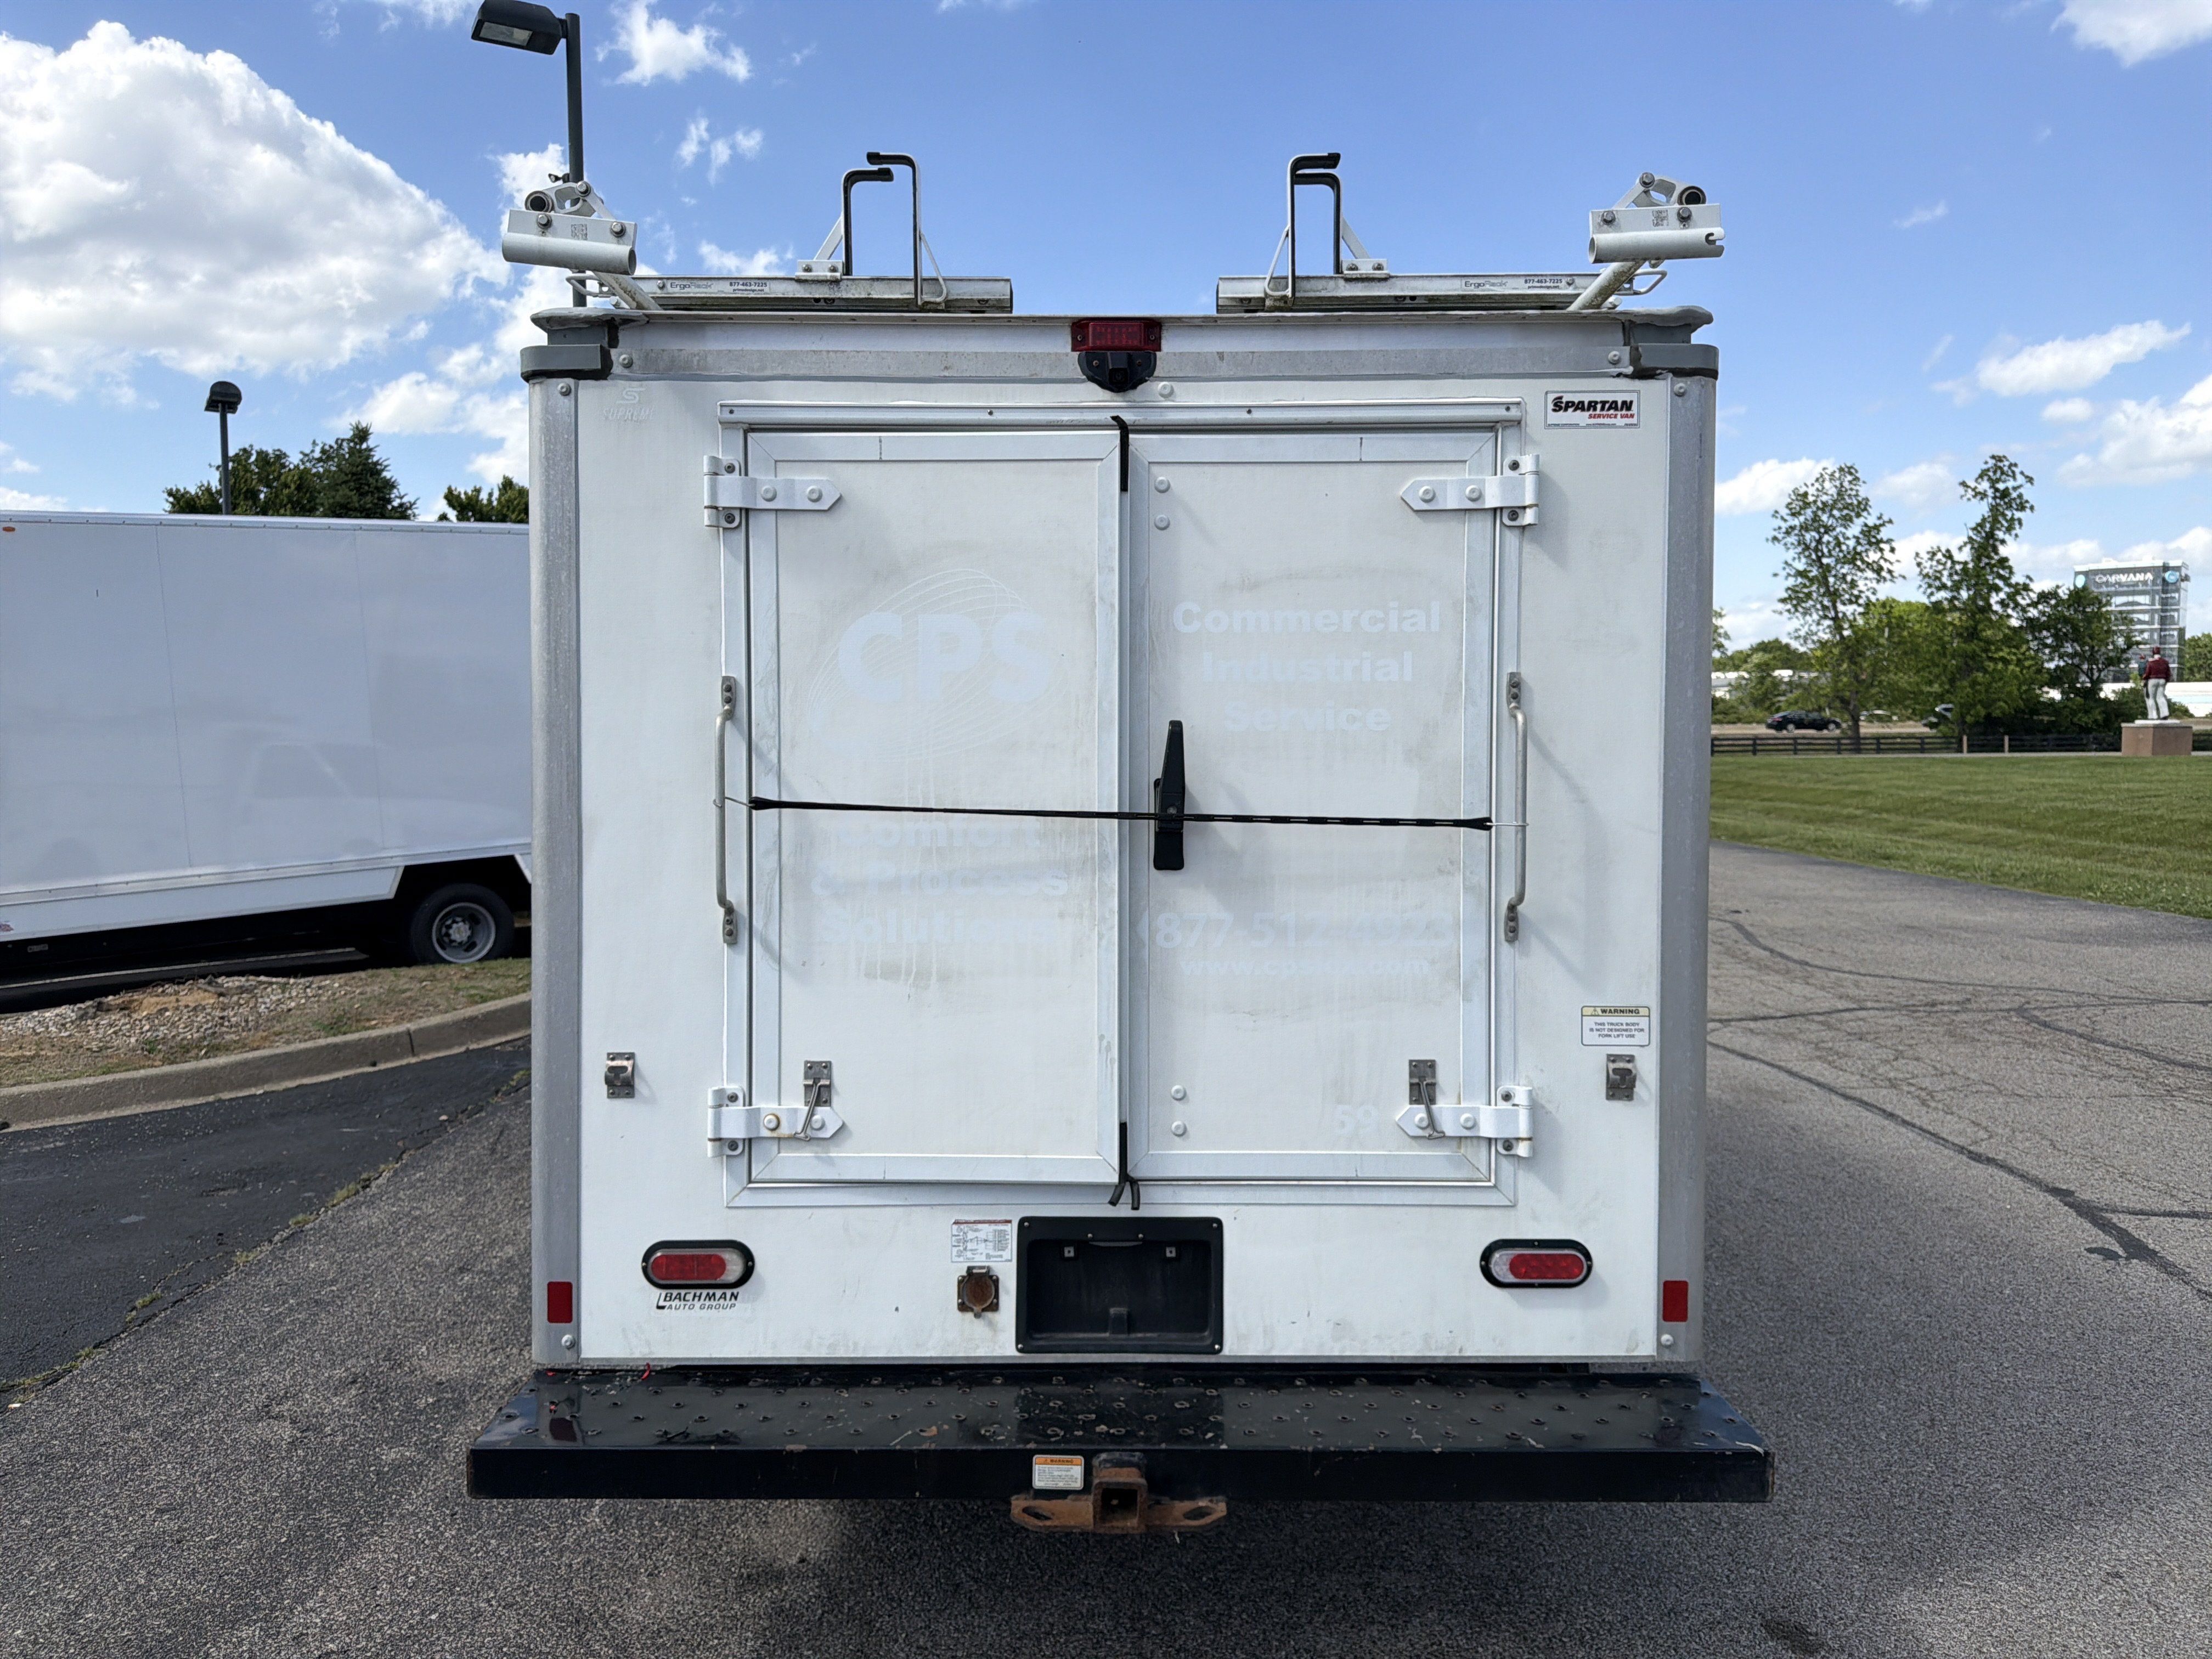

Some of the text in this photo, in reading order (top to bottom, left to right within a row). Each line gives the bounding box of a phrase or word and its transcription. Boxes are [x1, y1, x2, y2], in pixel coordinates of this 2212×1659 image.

[1551, 395, 1634, 413] SPARTAN
[2095, 572, 2153, 583] CARVANA
[1172, 601, 1441, 633] Commercial
[838, 611, 1051, 702] CPS
[1202, 651, 1414, 682] Industrial
[1224, 701, 1392, 731] Service
[663, 1291, 740, 1302] BACHMAN
